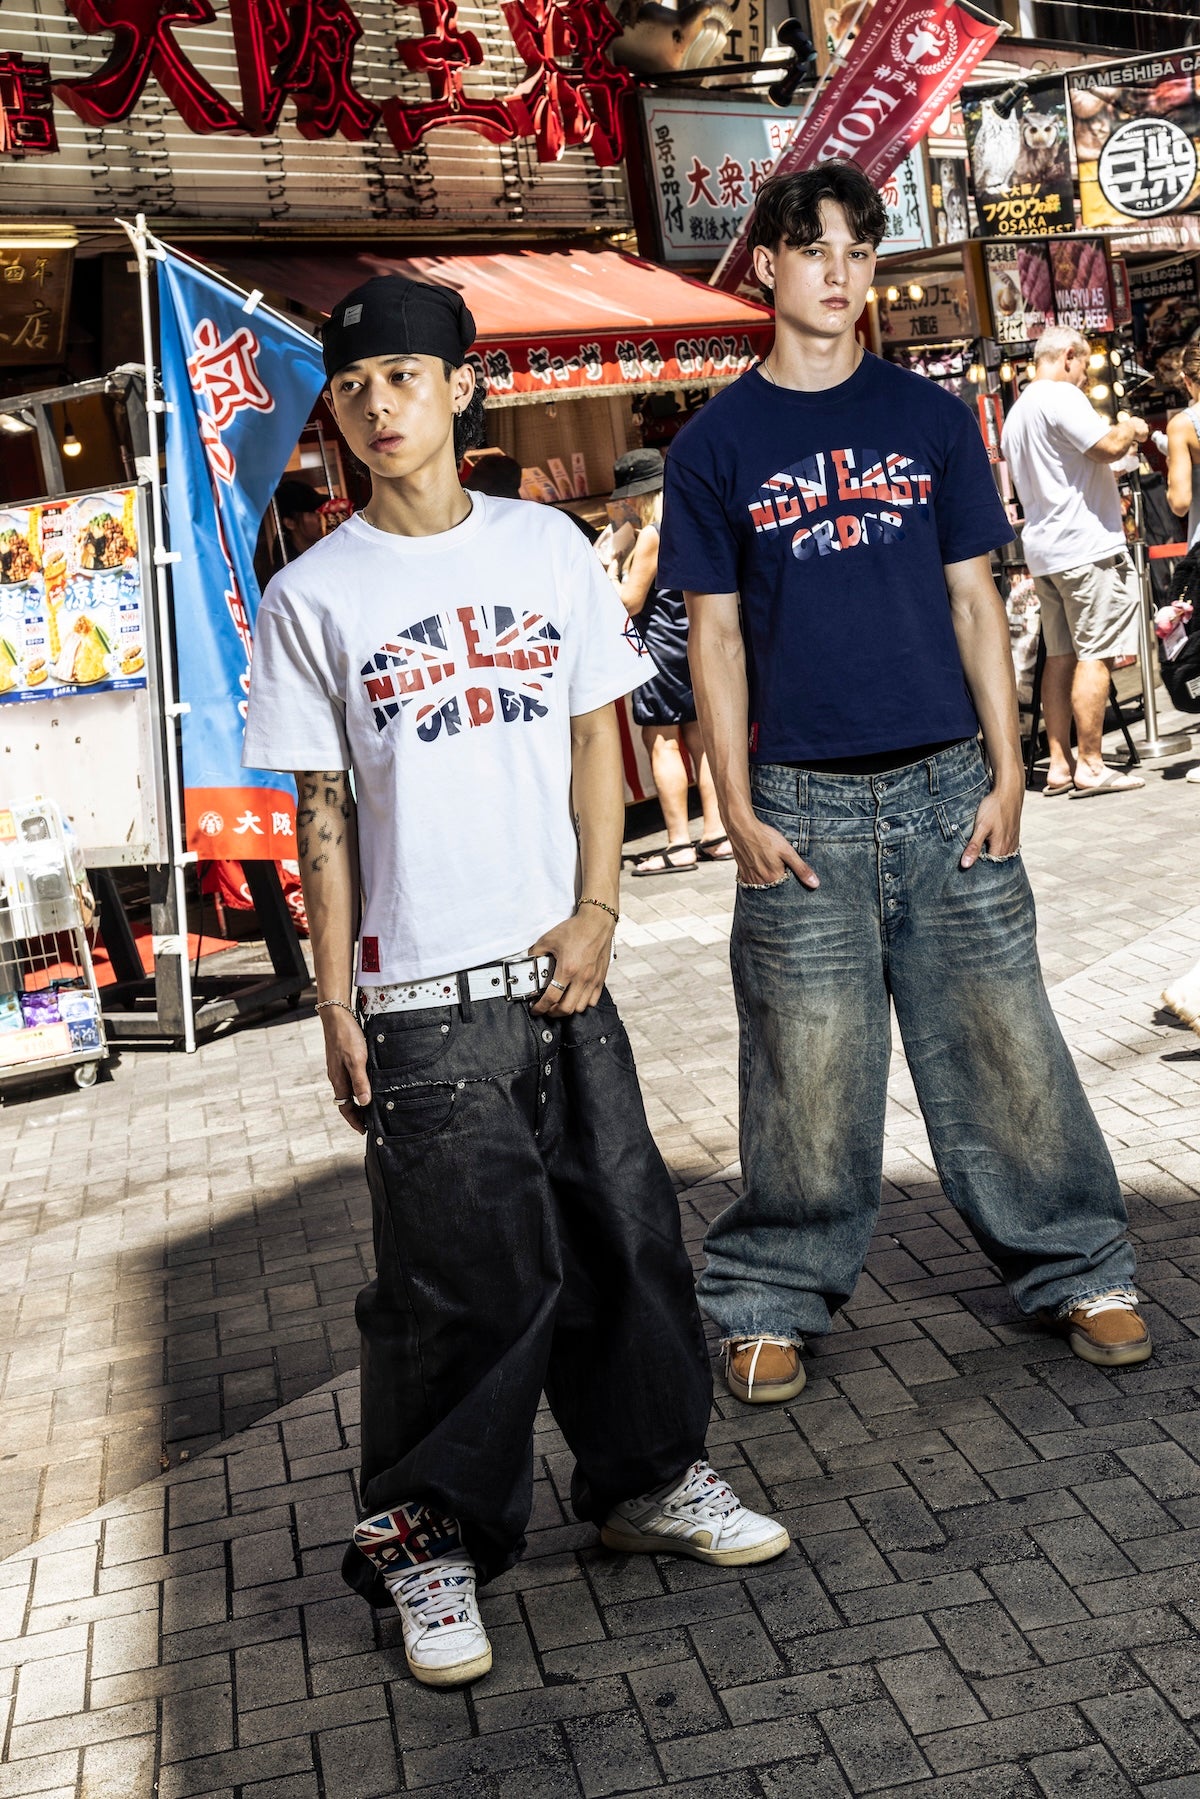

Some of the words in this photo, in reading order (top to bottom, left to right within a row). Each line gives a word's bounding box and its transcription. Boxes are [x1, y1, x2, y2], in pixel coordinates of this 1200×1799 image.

[748, 0, 759, 62] AFE
[1073, 61, 1176, 90] MAMESHIBA
[815, 84, 900, 166] KOB
[655, 125, 684, 235] 景品付
[982, 193, 1062, 222] フクロウの森
[1135, 199, 1164, 209] CAFE
[998, 215, 1047, 233] OSAKA
[1055, 288, 1090, 310] WAGYU
[1091, 287, 1105, 307] A5
[1057, 310, 1085, 330] KOBE
[1086, 307, 1109, 329] BEEF
[528, 344, 603, 385] ギョーザ
[615, 338, 665, 381] 餃子
[674, 335, 760, 374] GYOZA
[232, 809, 295, 837] 大阪
